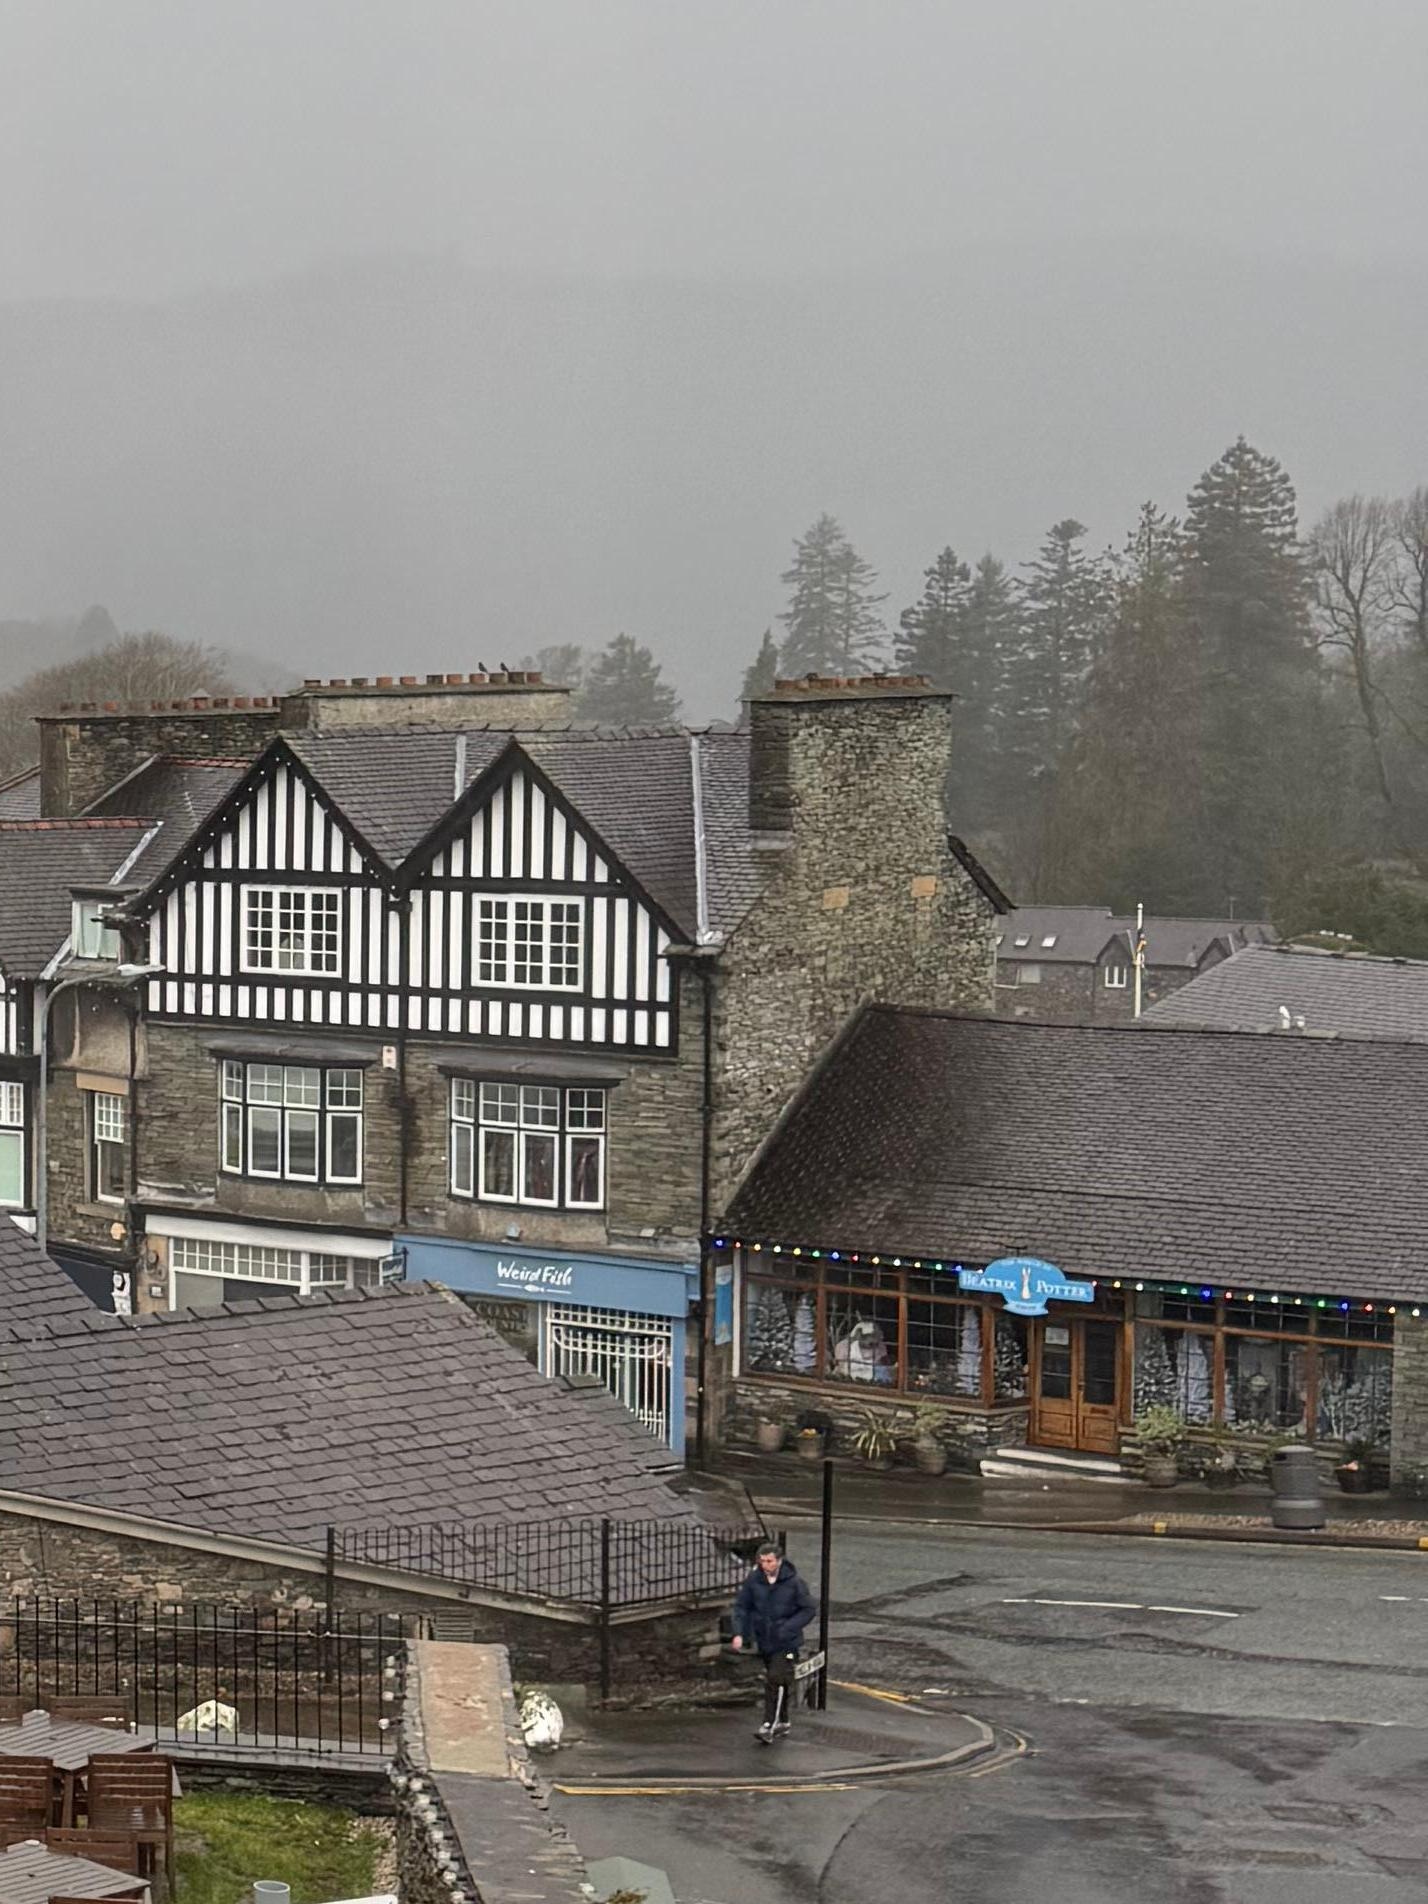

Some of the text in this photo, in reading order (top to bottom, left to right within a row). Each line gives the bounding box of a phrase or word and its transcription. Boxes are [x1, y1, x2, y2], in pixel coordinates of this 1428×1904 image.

[497, 1260, 573, 1286] Weird Fish
[1036, 1280, 1087, 1298] POTTER
